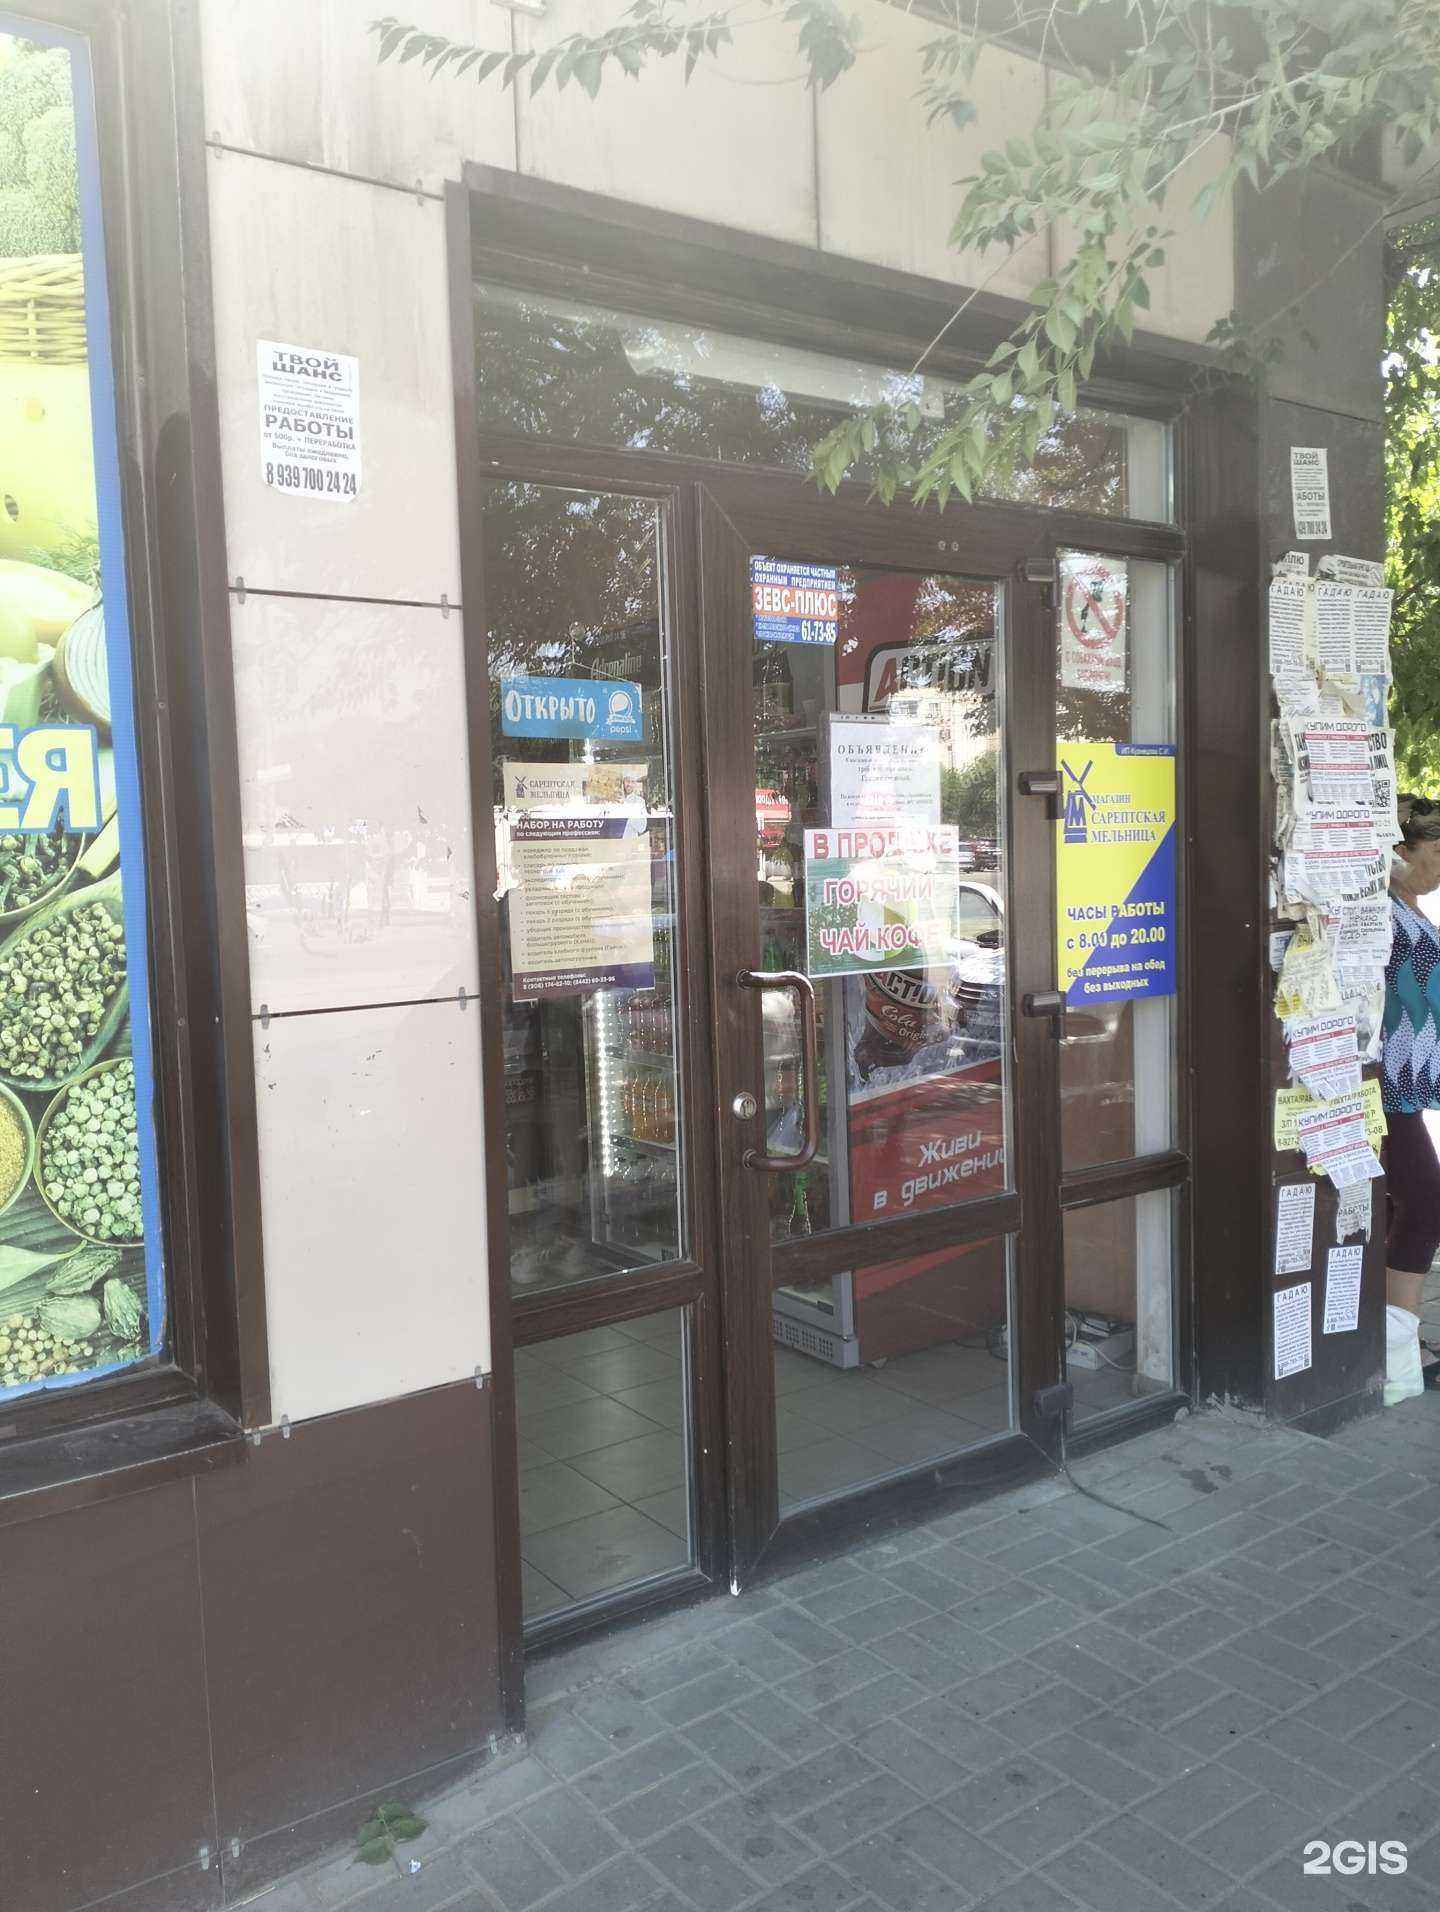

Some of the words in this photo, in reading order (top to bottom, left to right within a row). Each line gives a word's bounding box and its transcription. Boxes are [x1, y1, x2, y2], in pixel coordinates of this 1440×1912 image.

[273, 351, 339, 371] ТВОЙ
[273, 362, 342, 381] ШАНС
[266, 414, 353, 440] РАБОТЫ
[266, 462, 274, 484] 8
[277, 463, 300, 488] 939
[303, 467, 324, 491] 700
[327, 470, 341, 493] 24
[343, 473, 357, 495] 24
[755, 586, 837, 616] ЗЕВС-ПЛЮС
[801, 620, 836, 642] 61-73-85
[505, 689, 595, 724] ОТКРЫТО
[1092, 794, 1131, 804] МАГАЗИН
[517, 820, 549, 830] НАБОР
[552, 820, 565, 829] НА
[567, 819, 604, 828] РАБОТУ
[1091, 811, 1166, 825] САРЕПТСКАЯ
[1091, 829, 1157, 843] МЕЛЬНИЦА
[813, 833, 829, 860] В
[1067, 906, 1106, 921] ЧАСЫ
[1111, 901, 1165, 919] РАБОТЫ
[822, 923, 869, 954] ЧАЙ
[1079, 931, 1107, 948] 8.00
[1111, 933, 1127, 949] до
[1130, 926, 1165, 945] 20.00
[1067, 966, 1084, 979] без
[1085, 963, 1130, 979] перерыва
[1131, 962, 1143, 973] на
[1144, 958, 1165, 973] обед
[1083, 980, 1101, 994] без
[1102, 978, 1149, 993] выходных
[918, 1130, 983, 1168] Живи
[873, 1190, 888, 1211] в
[1281, 1186, 1312, 1199] ГАДАЮ
[1331, 1247, 1361, 1259] ГАДАЮ
[1277, 1286, 1308, 1302] ГАДАЮ
